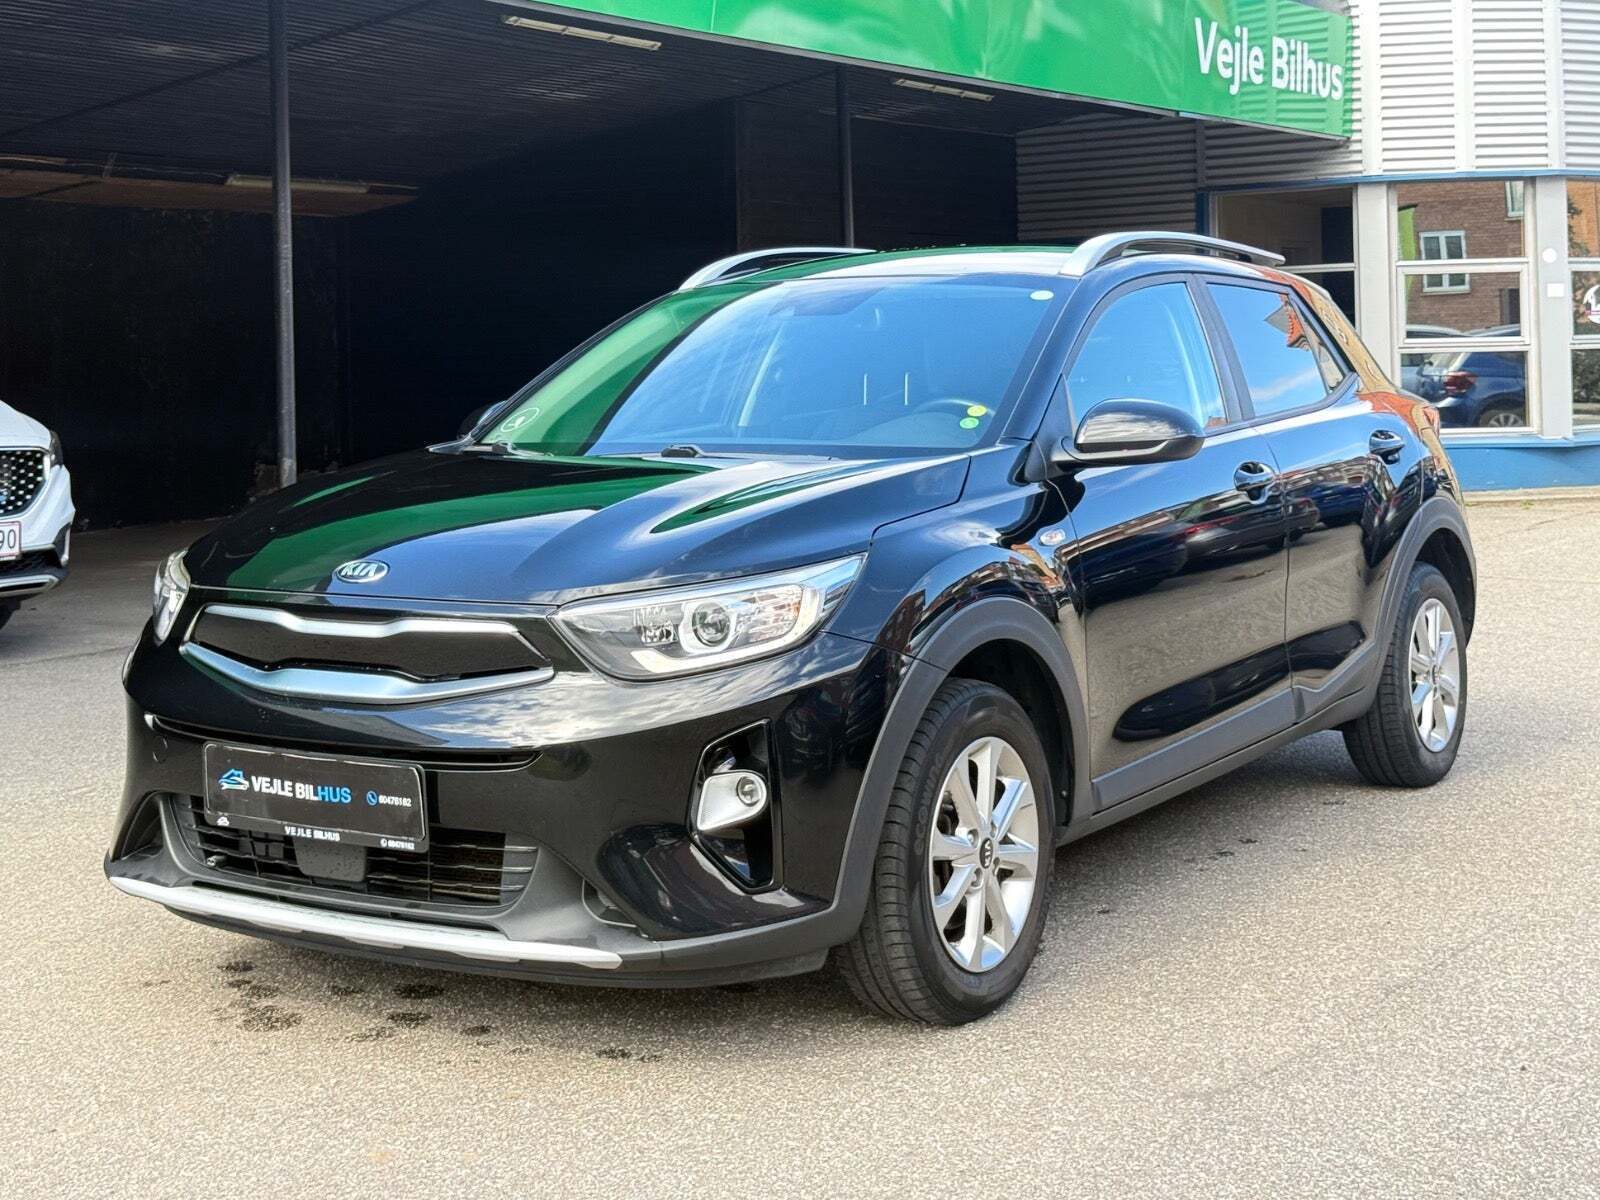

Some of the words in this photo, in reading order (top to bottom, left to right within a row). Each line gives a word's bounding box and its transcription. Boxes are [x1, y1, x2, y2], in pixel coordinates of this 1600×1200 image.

[1194, 17, 1265, 95] Vejle
[1271, 36, 1344, 100] Bilhus
[341, 562, 379, 577] KIA
[251, 776, 293, 797] VEJLE
[295, 783, 352, 804] BILHUS
[284, 825, 312, 838] VEJLE
